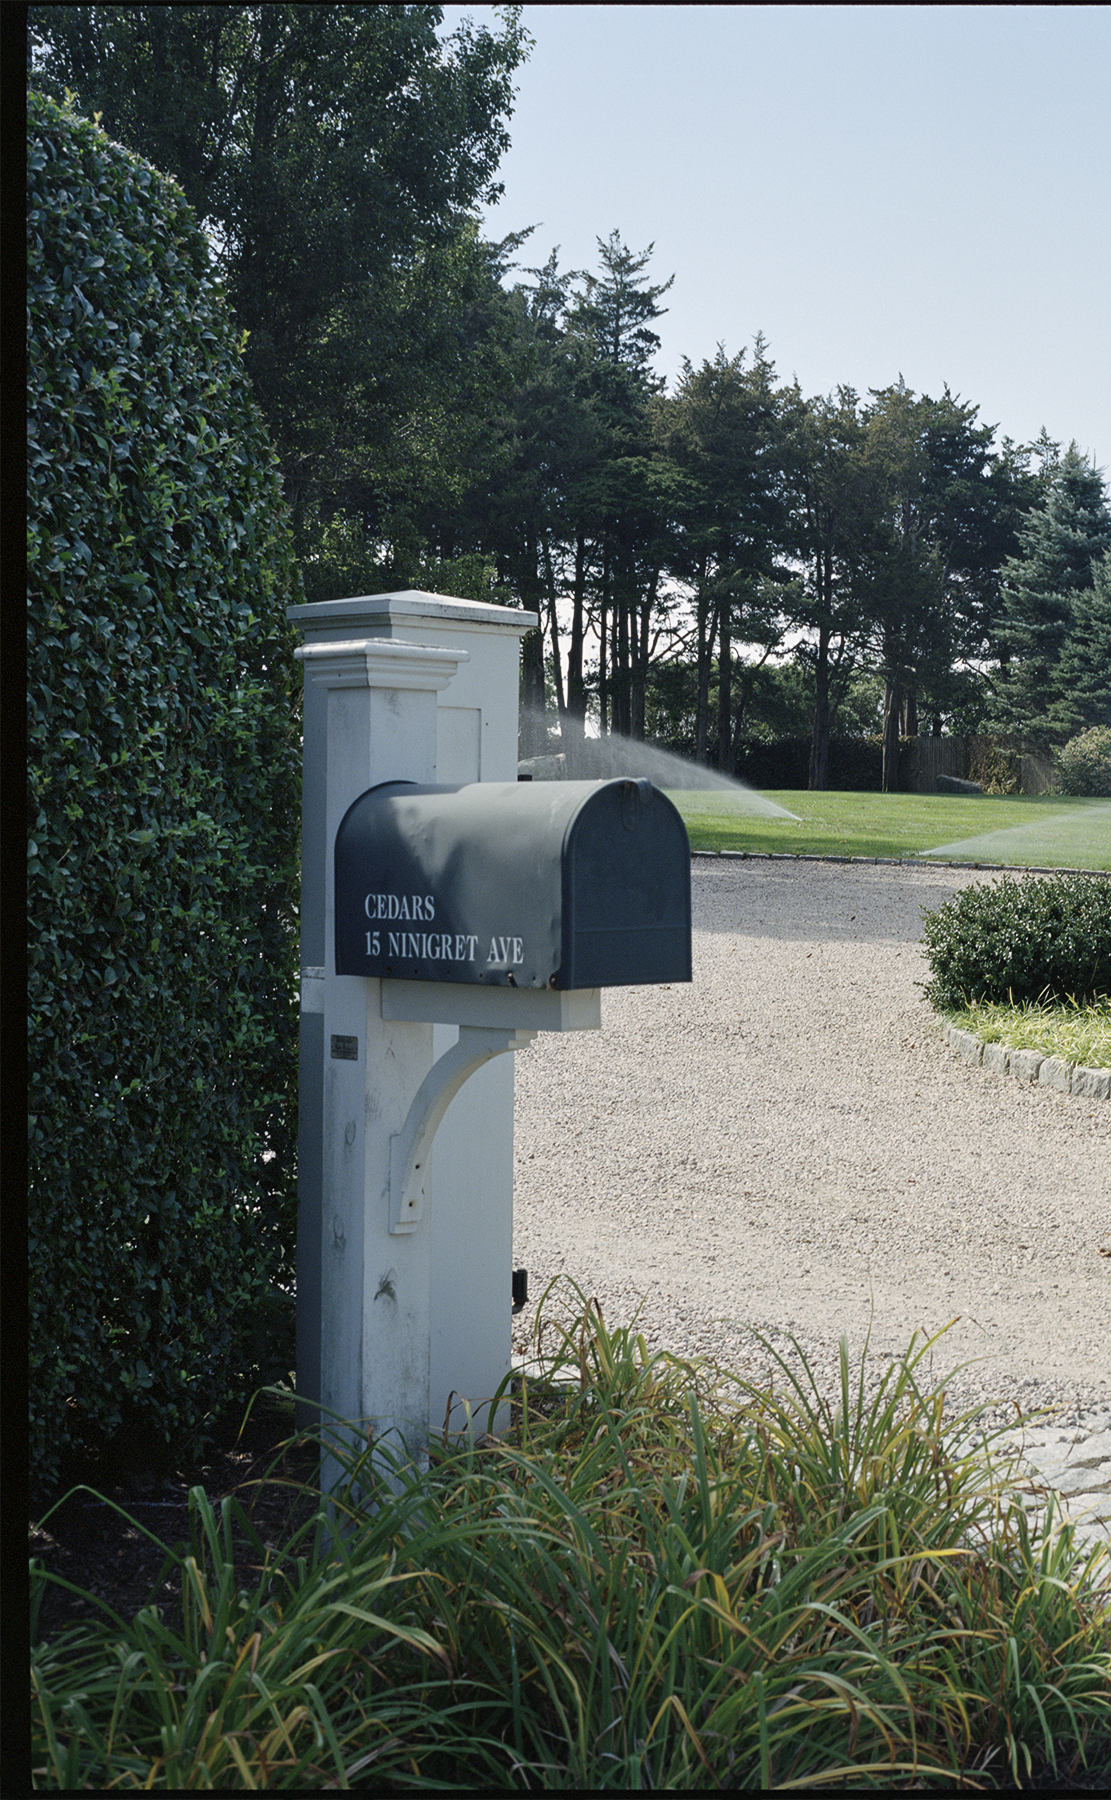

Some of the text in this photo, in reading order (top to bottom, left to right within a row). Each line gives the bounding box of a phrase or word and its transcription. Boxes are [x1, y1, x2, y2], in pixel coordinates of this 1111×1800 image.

[365, 894, 435, 921] CEDARS
[365, 931, 525, 964] 15 NINIGRET AVE
